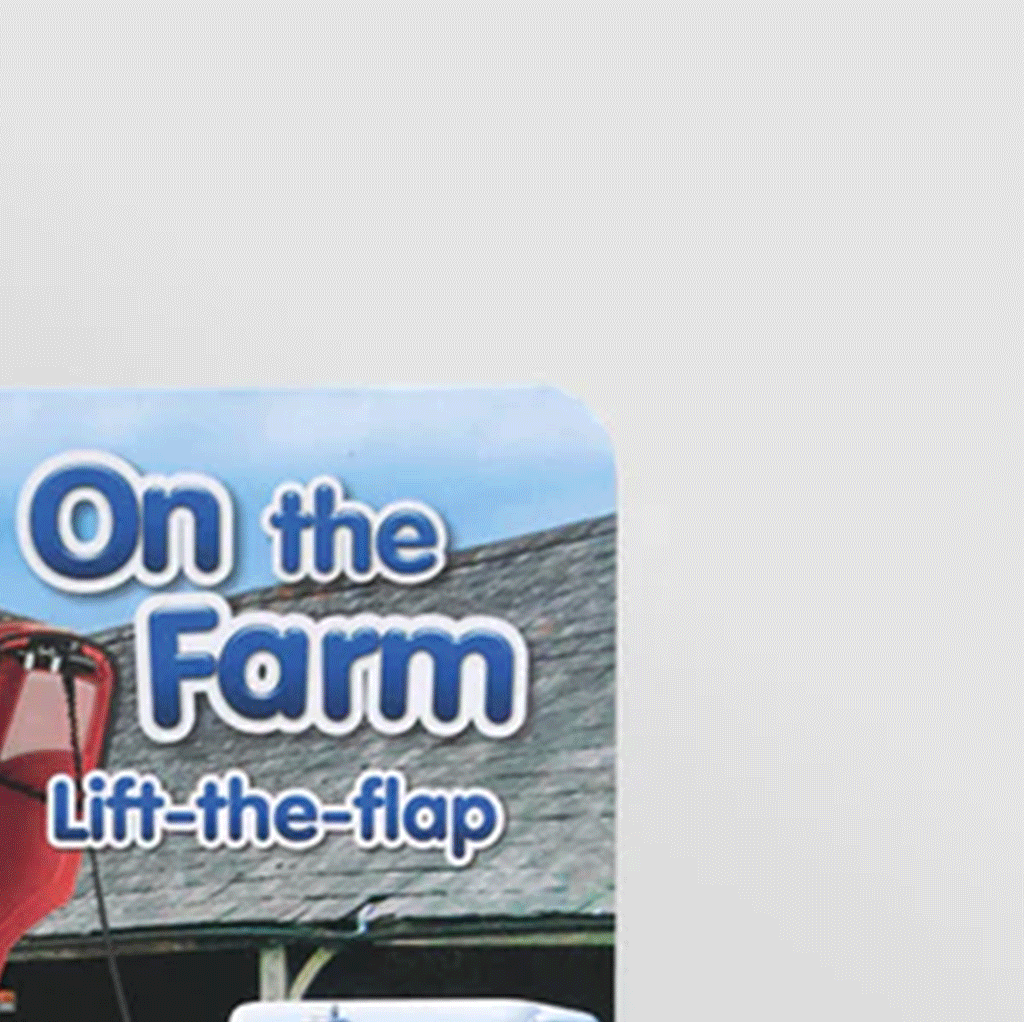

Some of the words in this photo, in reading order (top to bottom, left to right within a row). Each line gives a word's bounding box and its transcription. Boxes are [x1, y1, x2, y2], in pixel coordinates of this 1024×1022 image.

[27, 462, 222, 581] On
[269, 480, 440, 577] the
[146, 605, 515, 731] Farm
[50, 774, 499, 860] Lift-the-flap
